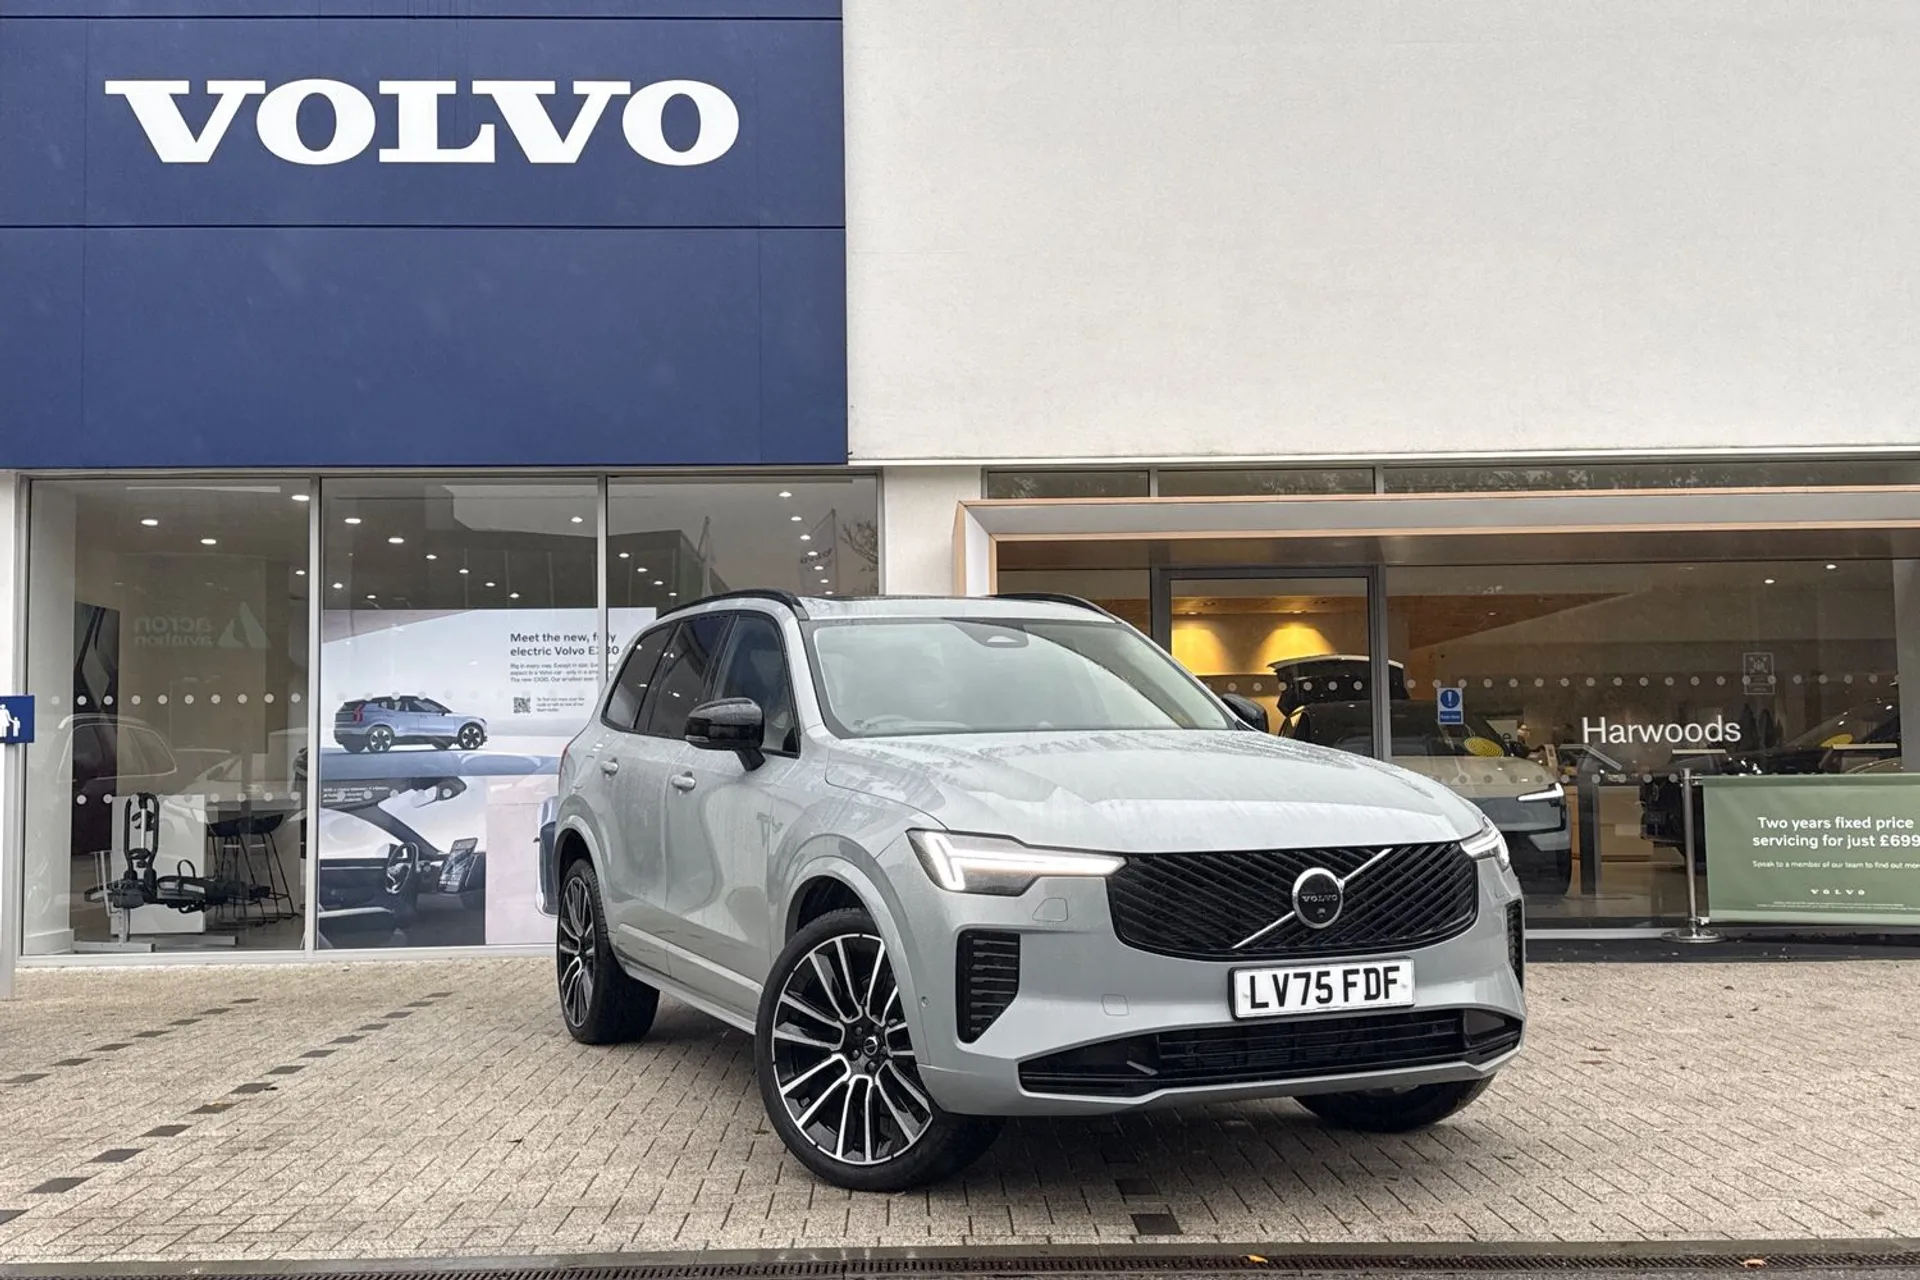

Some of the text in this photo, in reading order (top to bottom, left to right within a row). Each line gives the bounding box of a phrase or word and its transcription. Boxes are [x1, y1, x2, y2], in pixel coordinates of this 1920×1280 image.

[105, 79, 740, 166] VOLVO
[510, 632, 539, 643] Meet
[542, 632, 561, 643] the
[563, 632, 590, 643] new,
[510, 645, 552, 656] electric
[554, 645, 585, 656] Volvo
[1582, 714, 1742, 744] Harwoods
[1757, 816, 1914, 831] Two years fixed price
[1752, 834, 1920, 849] servicing for just £699
[1752, 860, 1775, 868] Speak
[1874, 861, 1889, 869] find
[1302, 893, 1338, 903] VOLVO
[1810, 888, 1866, 896] VOLVO
[1249, 965, 1401, 1010] LV75 FDF
